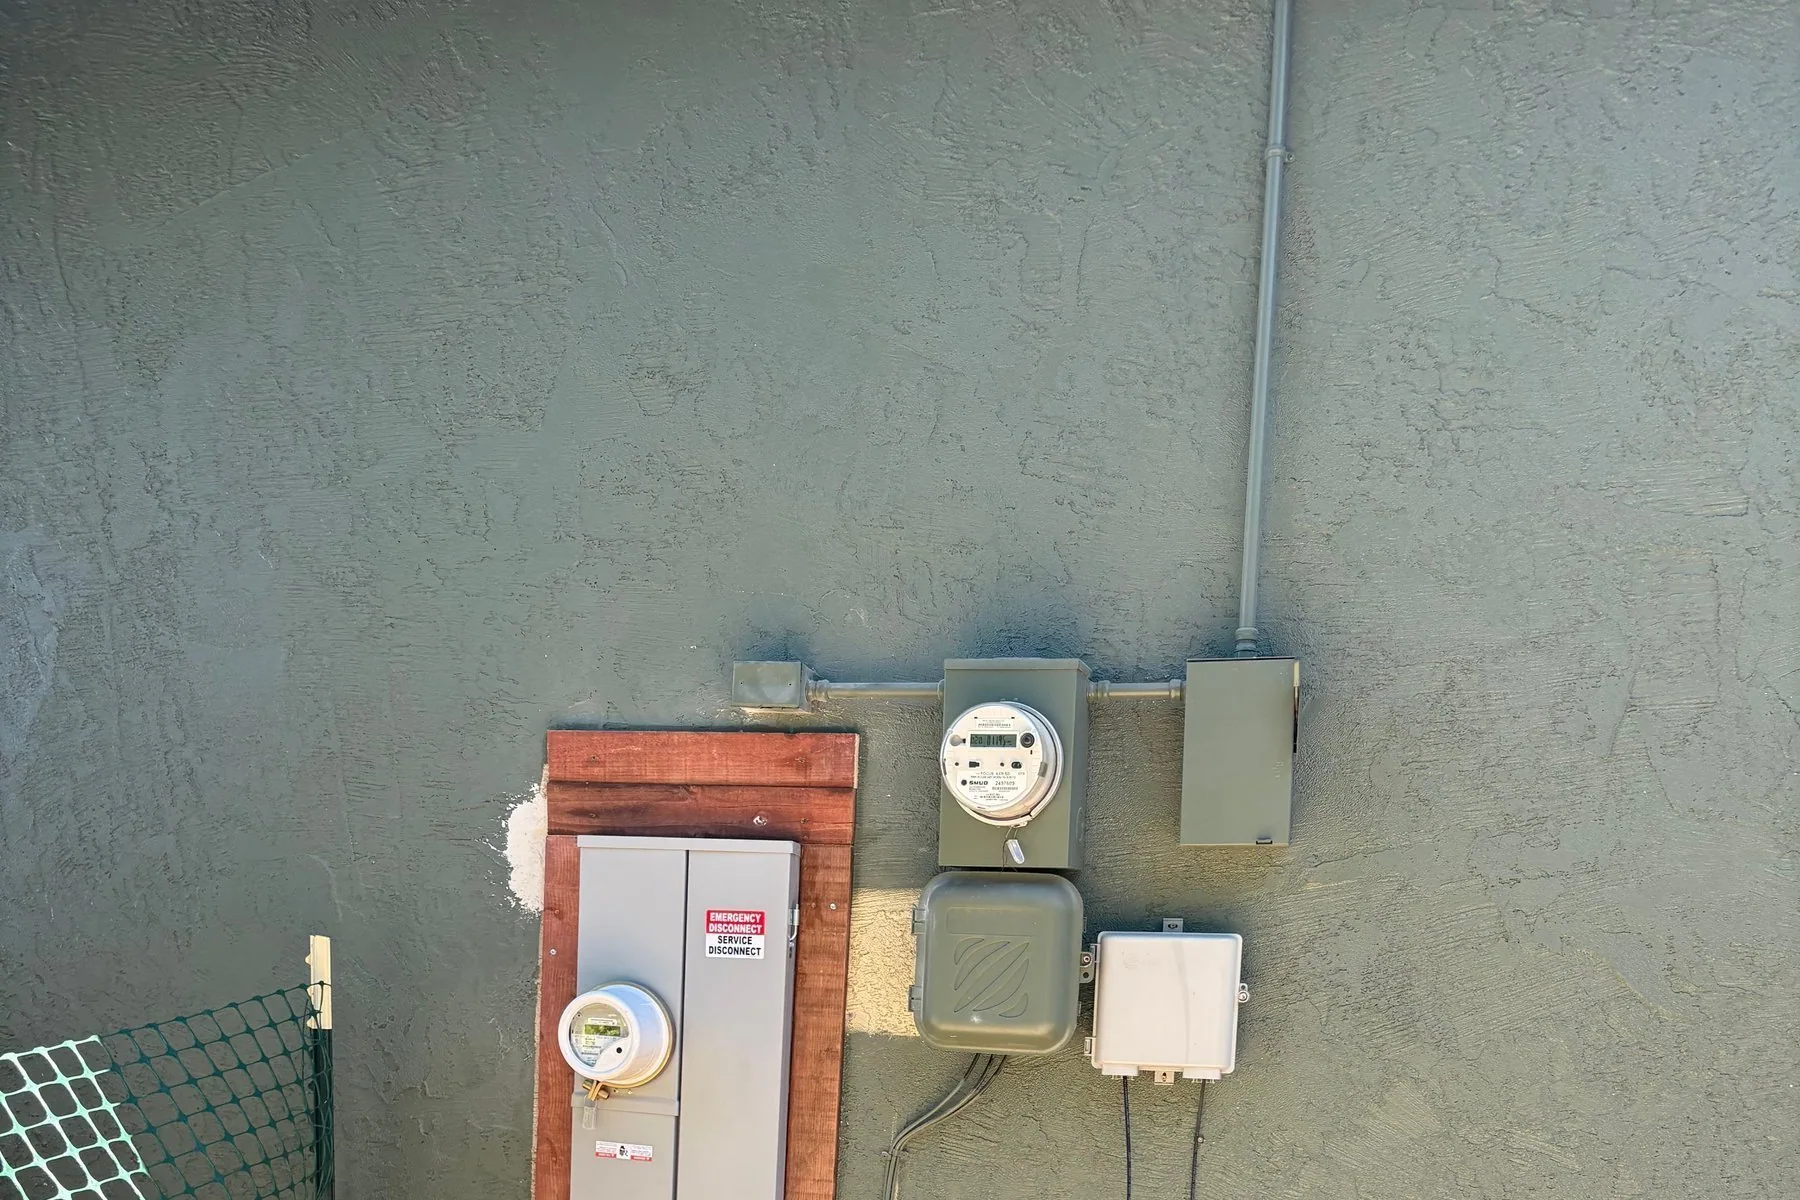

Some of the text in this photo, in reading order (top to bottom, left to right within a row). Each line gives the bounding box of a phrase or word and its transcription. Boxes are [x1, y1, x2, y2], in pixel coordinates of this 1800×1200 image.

[710, 912, 762, 923] EMERGENCY
[708, 922, 763, 934] DISCONNECT
[717, 935, 753, 945] SERVICE
[708, 945, 762, 956] DISCONNECT
